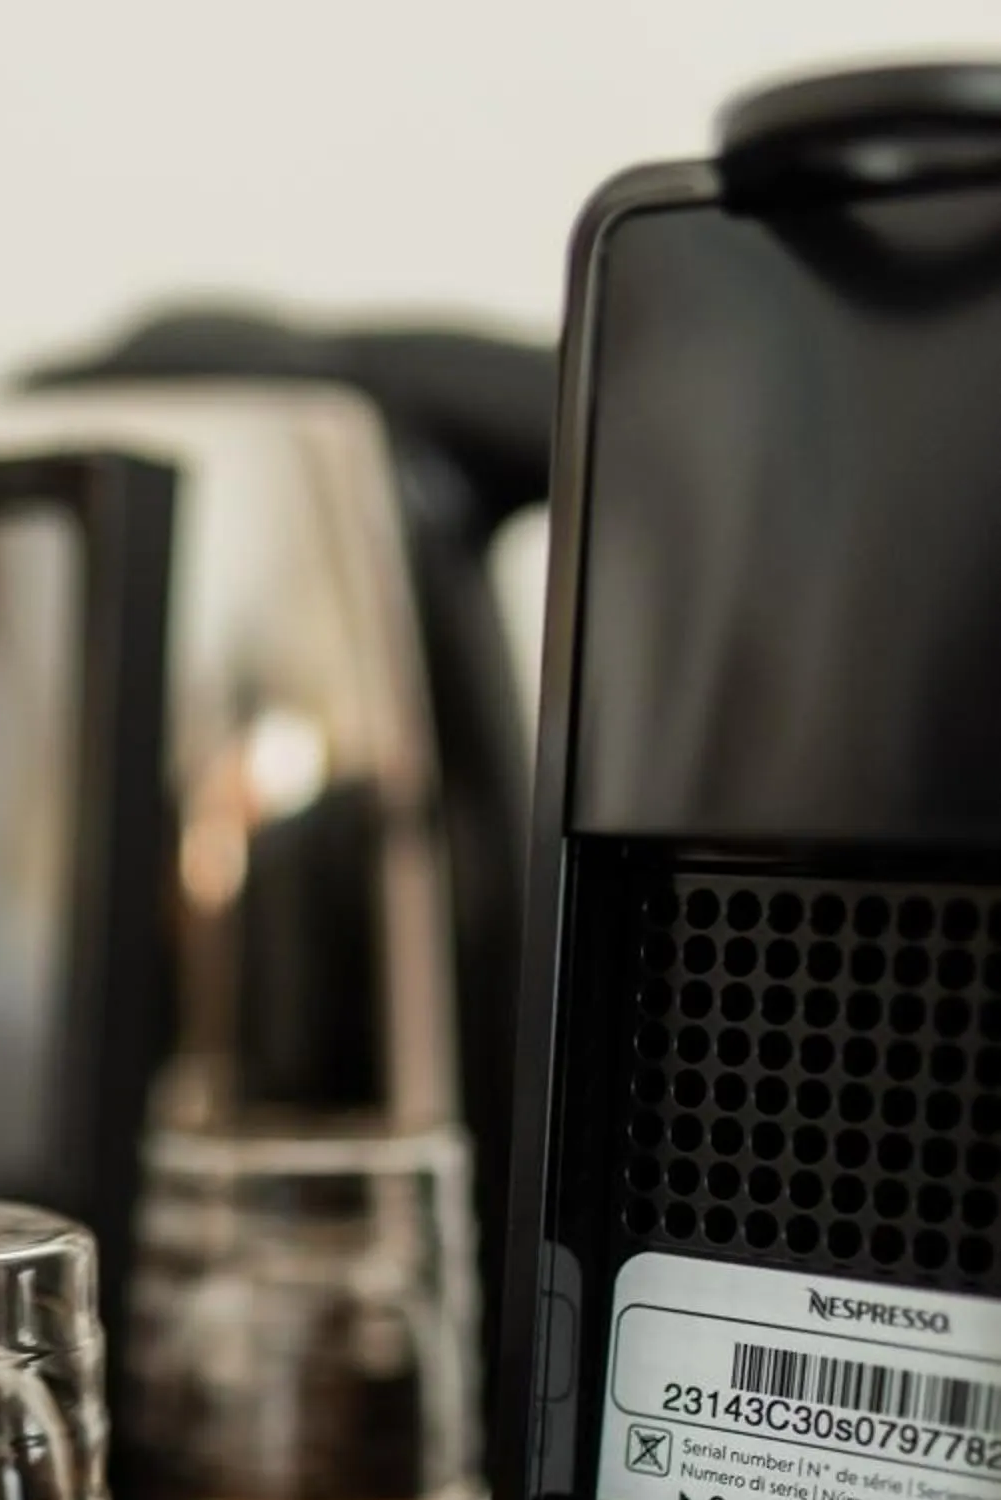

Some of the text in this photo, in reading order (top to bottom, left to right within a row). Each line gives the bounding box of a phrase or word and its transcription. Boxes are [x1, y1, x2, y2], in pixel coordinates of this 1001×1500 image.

[806, 1287, 952, 1335] NESPRESSO
[681, 1461, 746, 1489] Numero
[749, 1475, 766, 1492] di
[769, 1481, 808, 1500] serie
[682, 1437, 726, 1460] Serial
[730, 1449, 794, 1473] number
[836, 1469, 858, 1486] de
